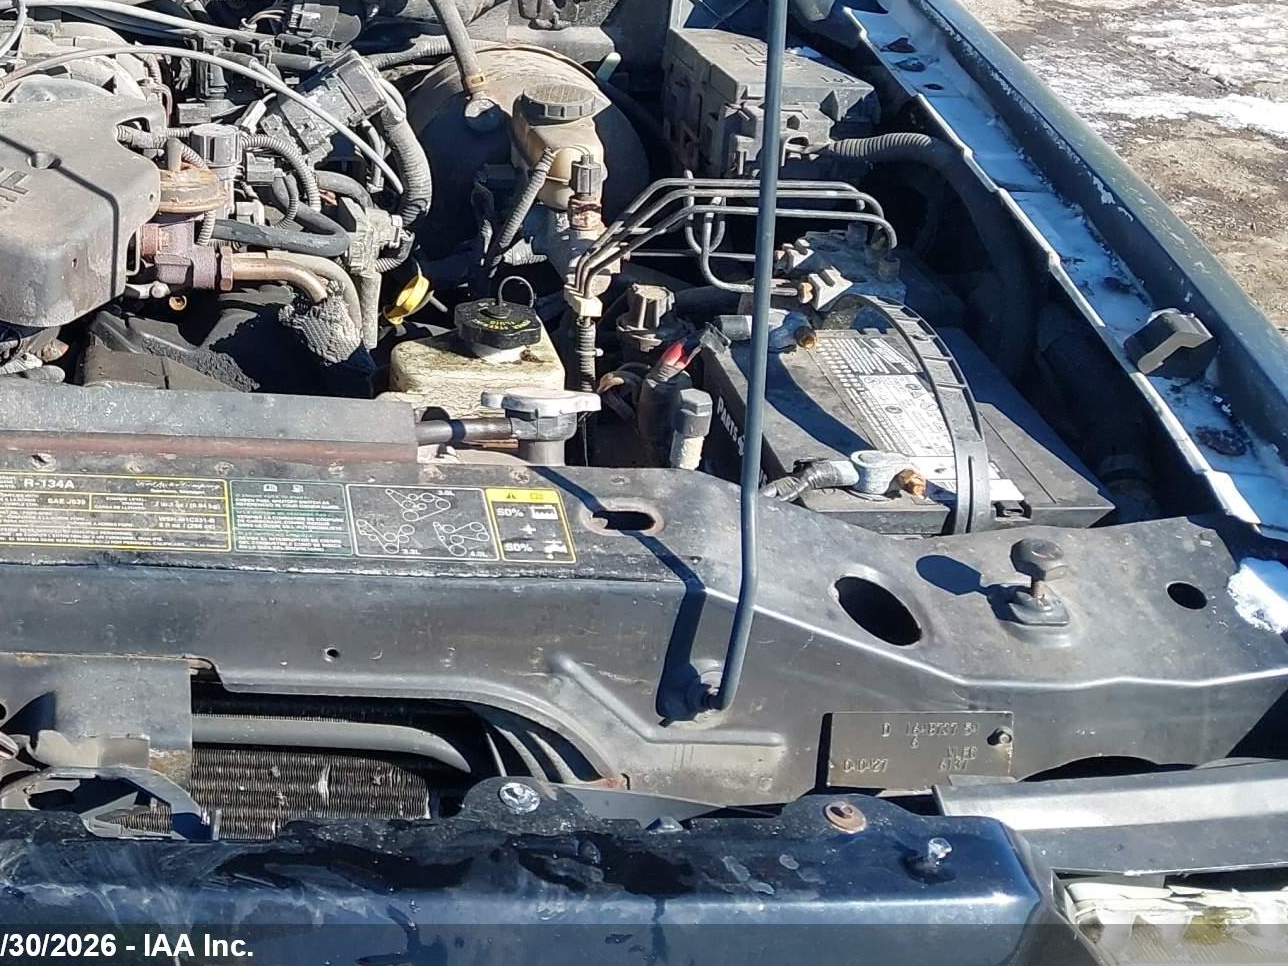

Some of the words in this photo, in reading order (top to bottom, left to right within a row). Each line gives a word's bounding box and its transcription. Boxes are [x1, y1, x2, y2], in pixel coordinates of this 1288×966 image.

[716, 395, 739, 443] PARTS
[23, 478, 75, 490] R-134A
[496, 507, 524, 518] 50%
[504, 543, 533, 553] 50%
